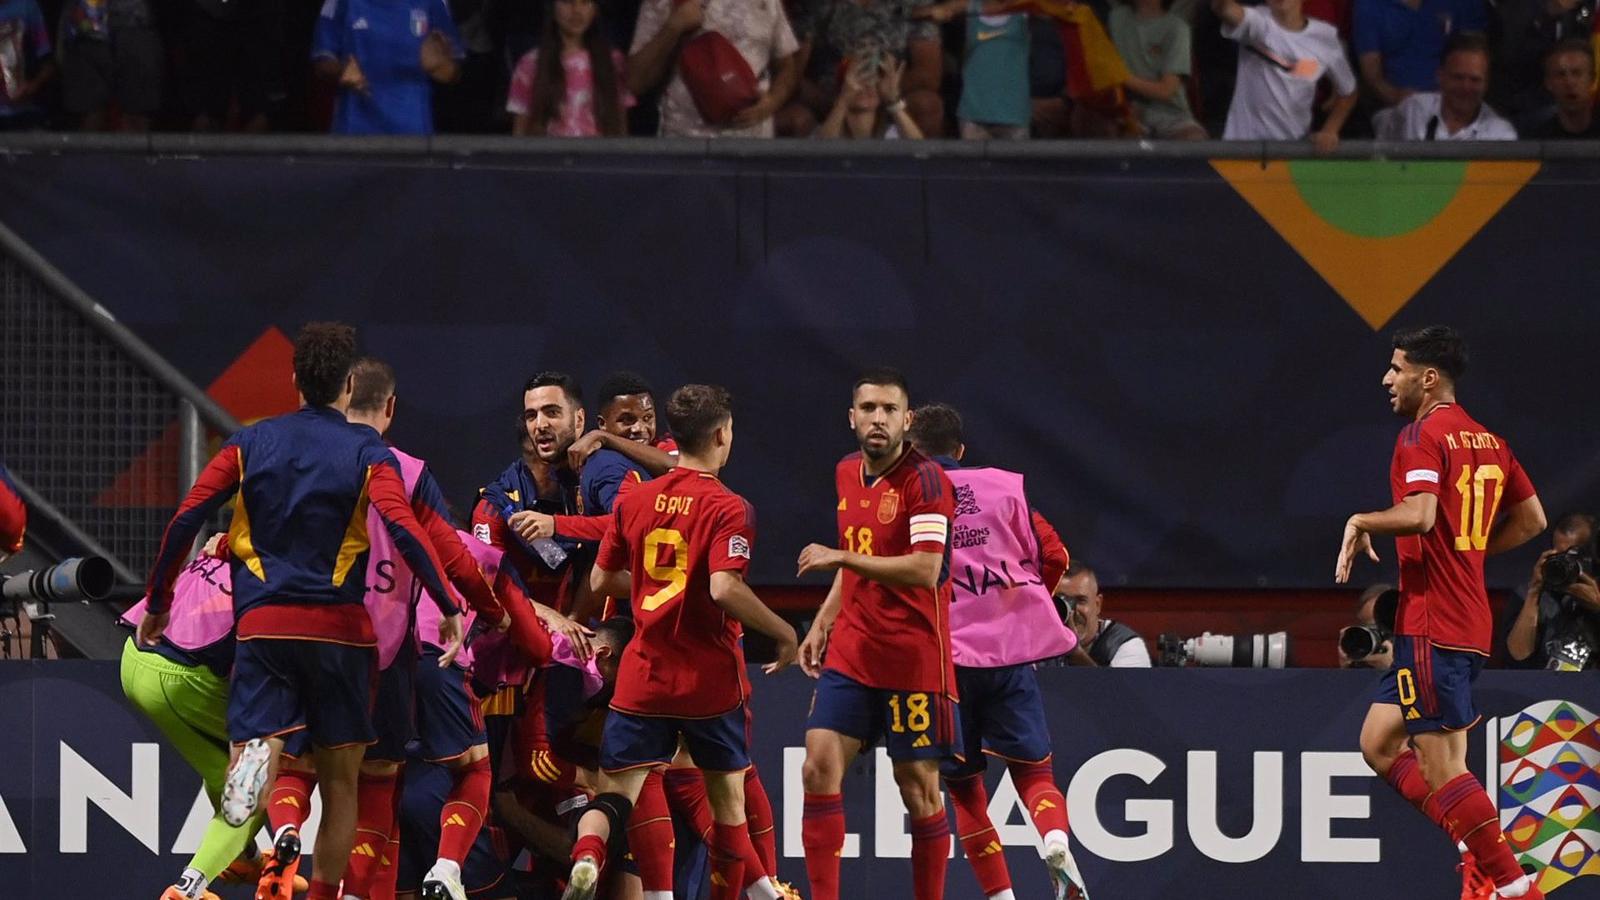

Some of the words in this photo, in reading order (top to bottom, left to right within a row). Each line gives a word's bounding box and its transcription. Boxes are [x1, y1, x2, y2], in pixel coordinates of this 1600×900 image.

[654, 493, 694, 515] GAVI
[1454, 464, 1505, 551] 10
[844, 526, 873, 556] 18
[952, 536, 988, 550] EAGUE
[953, 527, 990, 541] ATIONS
[641, 527, 688, 611] 9
[950, 559, 1043, 602] NALS
[888, 692, 930, 733] 18
